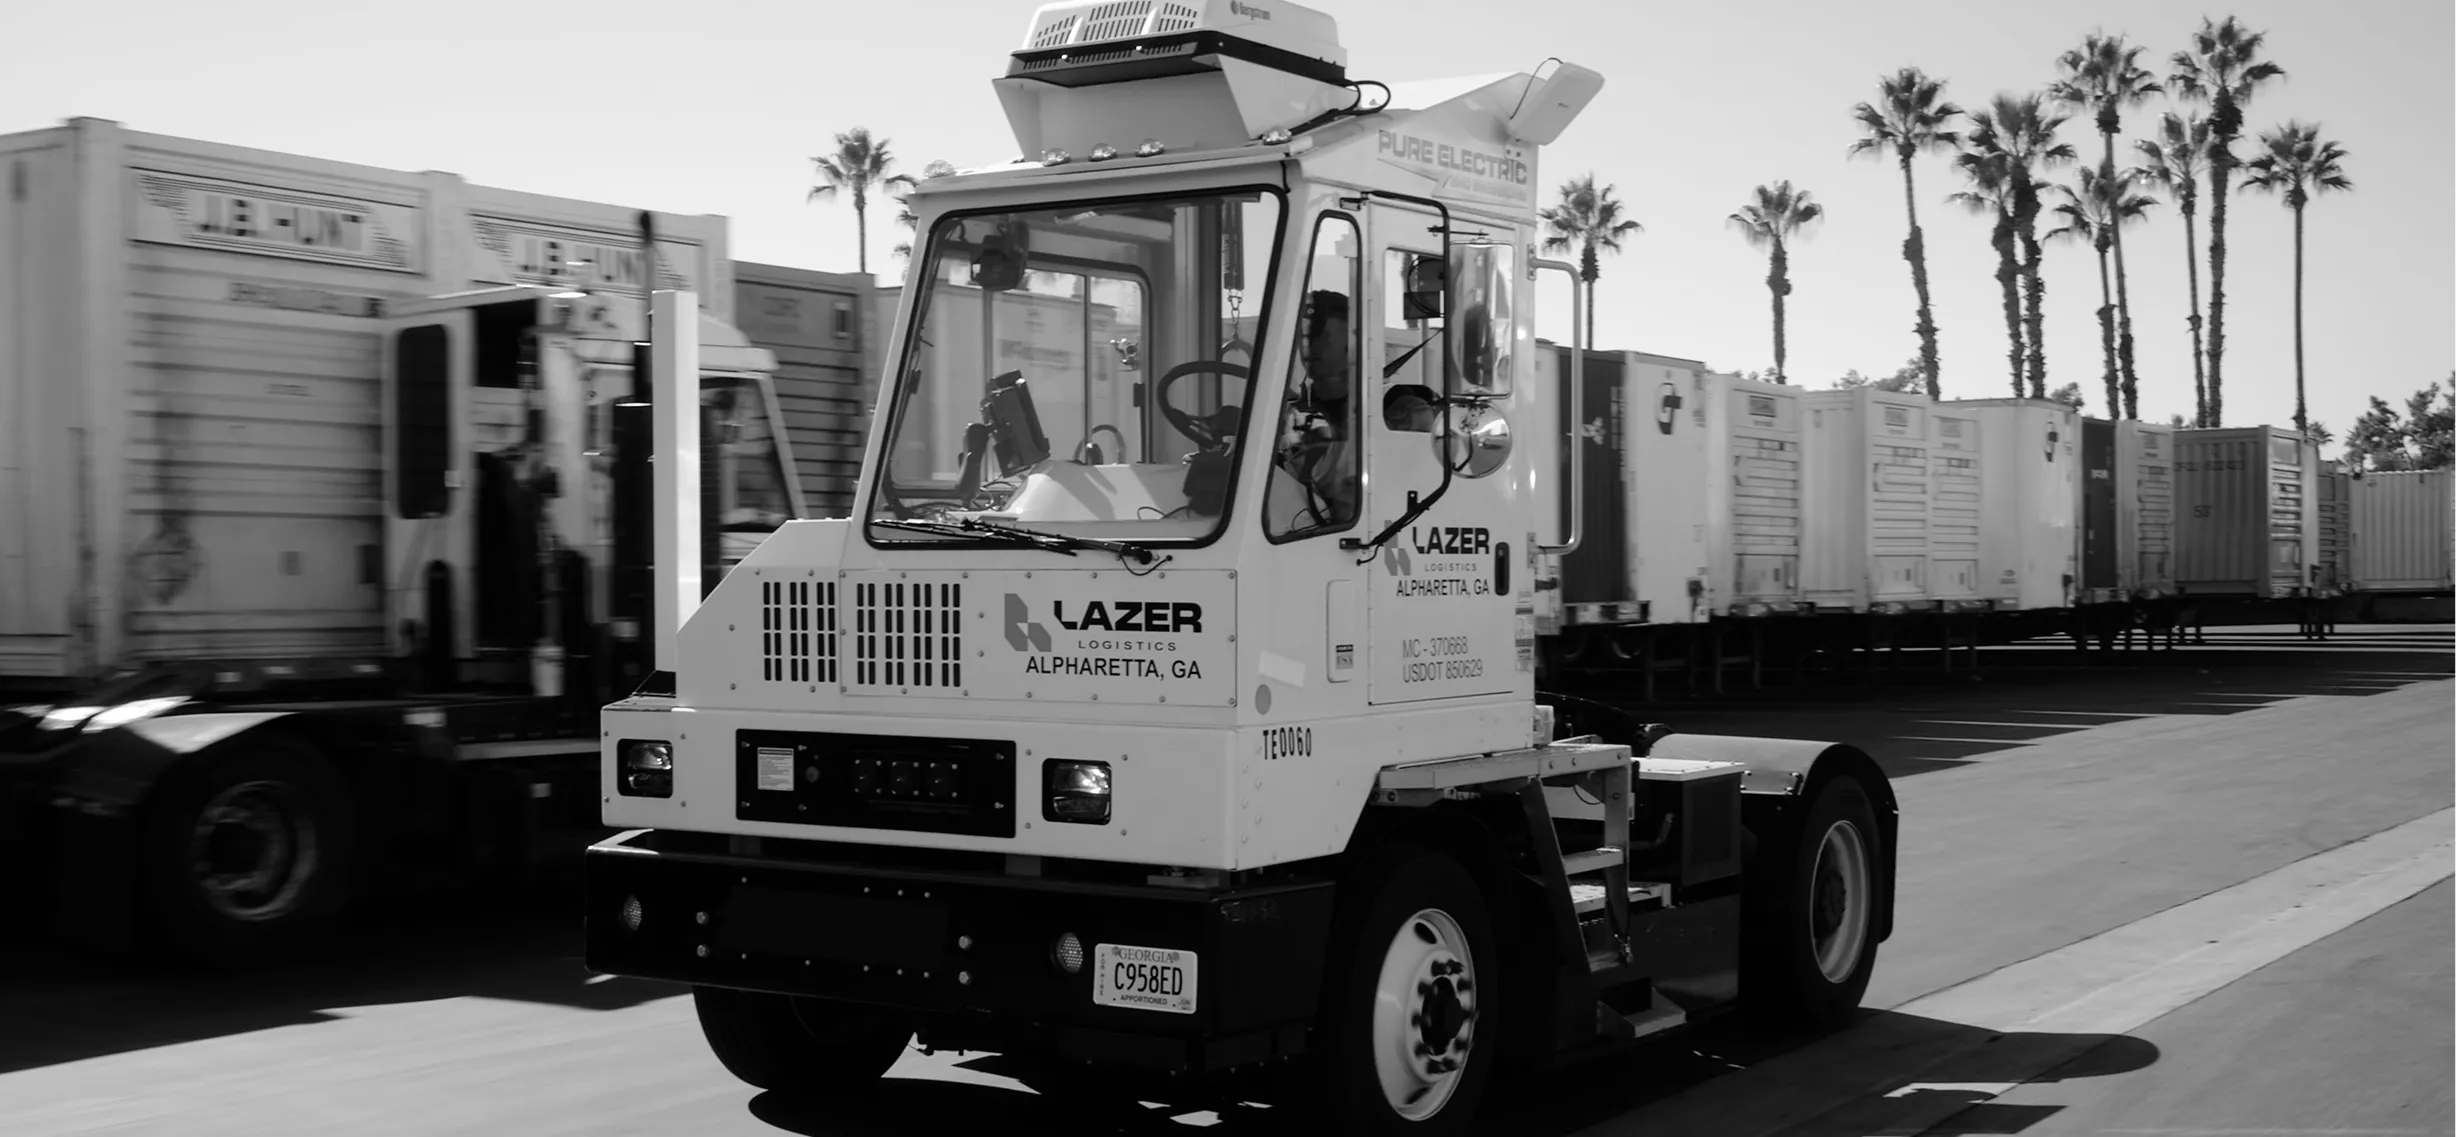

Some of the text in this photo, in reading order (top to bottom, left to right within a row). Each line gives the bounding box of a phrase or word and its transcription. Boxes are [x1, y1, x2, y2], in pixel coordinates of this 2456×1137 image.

[1379, 129, 1527, 185] PURE ELECTRIC
[1412, 526, 1490, 554] LAZER
[1424, 563, 1477, 572] LOGISTICS
[1396, 578, 1490, 597] ALPHARETTA, GA
[1053, 600, 1202, 633] LAZER
[1078, 640, 1177, 652] LOGISTICS
[1402, 638, 1420, 658] MC
[1025, 656, 1202, 681] ALPHARETTA, GA
[1402, 658, 1483, 683] USDOT 850629
[1262, 726, 1312, 760] TE0060
[1119, 948, 1174, 964] GEORGIA
[1114, 962, 1183, 996] C958ED
[1120, 994, 1168, 1005] APPORTIONED
